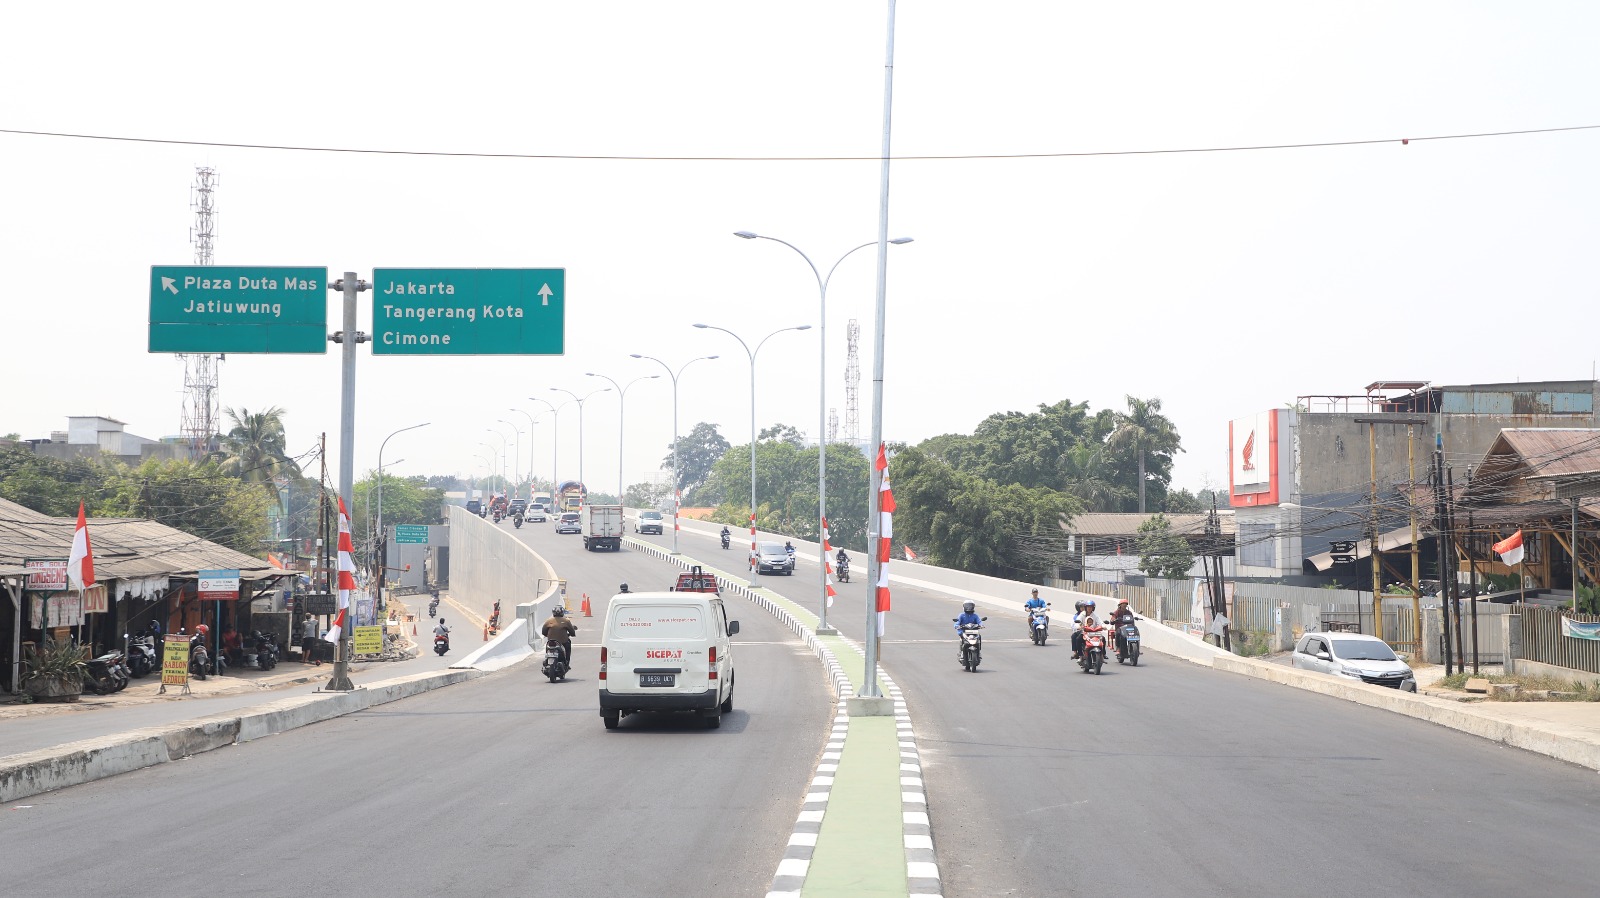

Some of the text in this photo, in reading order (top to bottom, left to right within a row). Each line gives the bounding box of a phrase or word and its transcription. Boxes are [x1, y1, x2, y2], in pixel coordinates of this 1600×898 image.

[184, 276, 317, 290] Plaza Duta Mas
[383, 281, 455, 295] Jakarta
[183, 300, 282, 317] Jatiuwung
[383, 305, 524, 322] Tangerang Kota
[382, 331, 451, 345] Cimone
[646, 650, 683, 659] SICEPAT
[164, 661, 187, 669] SABLON
[162, 675, 187, 684] AFDRUK
